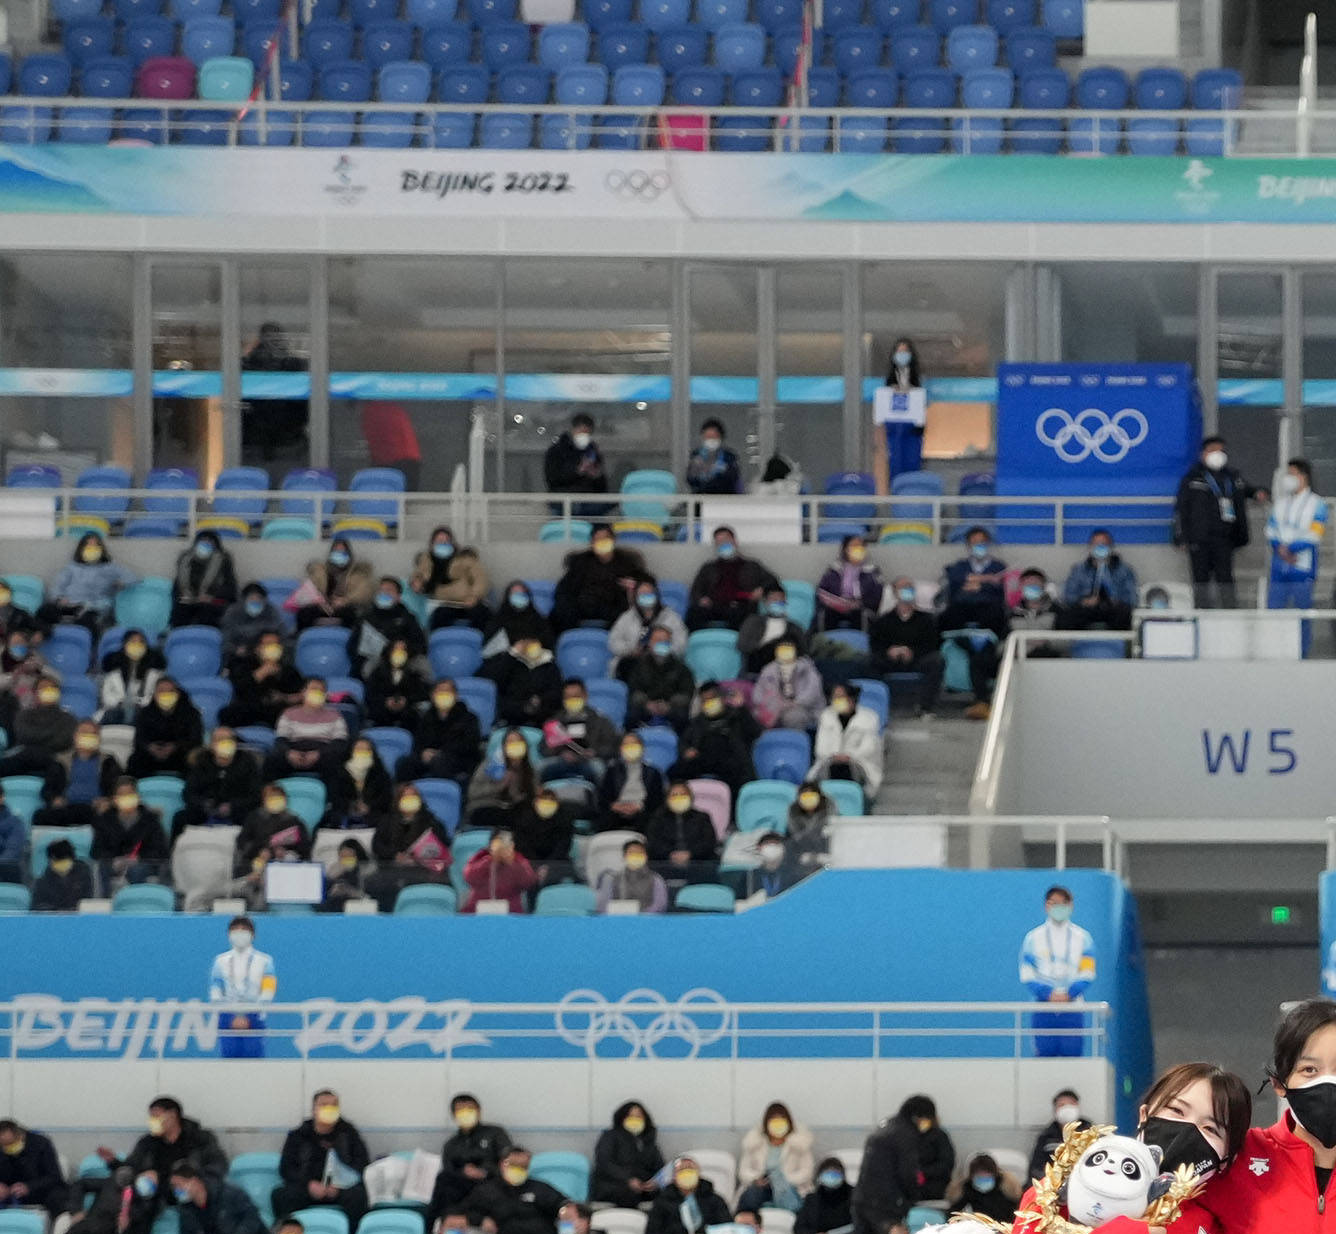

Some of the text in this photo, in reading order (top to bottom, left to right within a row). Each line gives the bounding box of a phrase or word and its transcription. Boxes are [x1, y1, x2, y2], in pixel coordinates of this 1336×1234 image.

[401, 170, 574, 197] BEIJING 2022
[11, 994, 493, 1060] BEIJIN 2022
